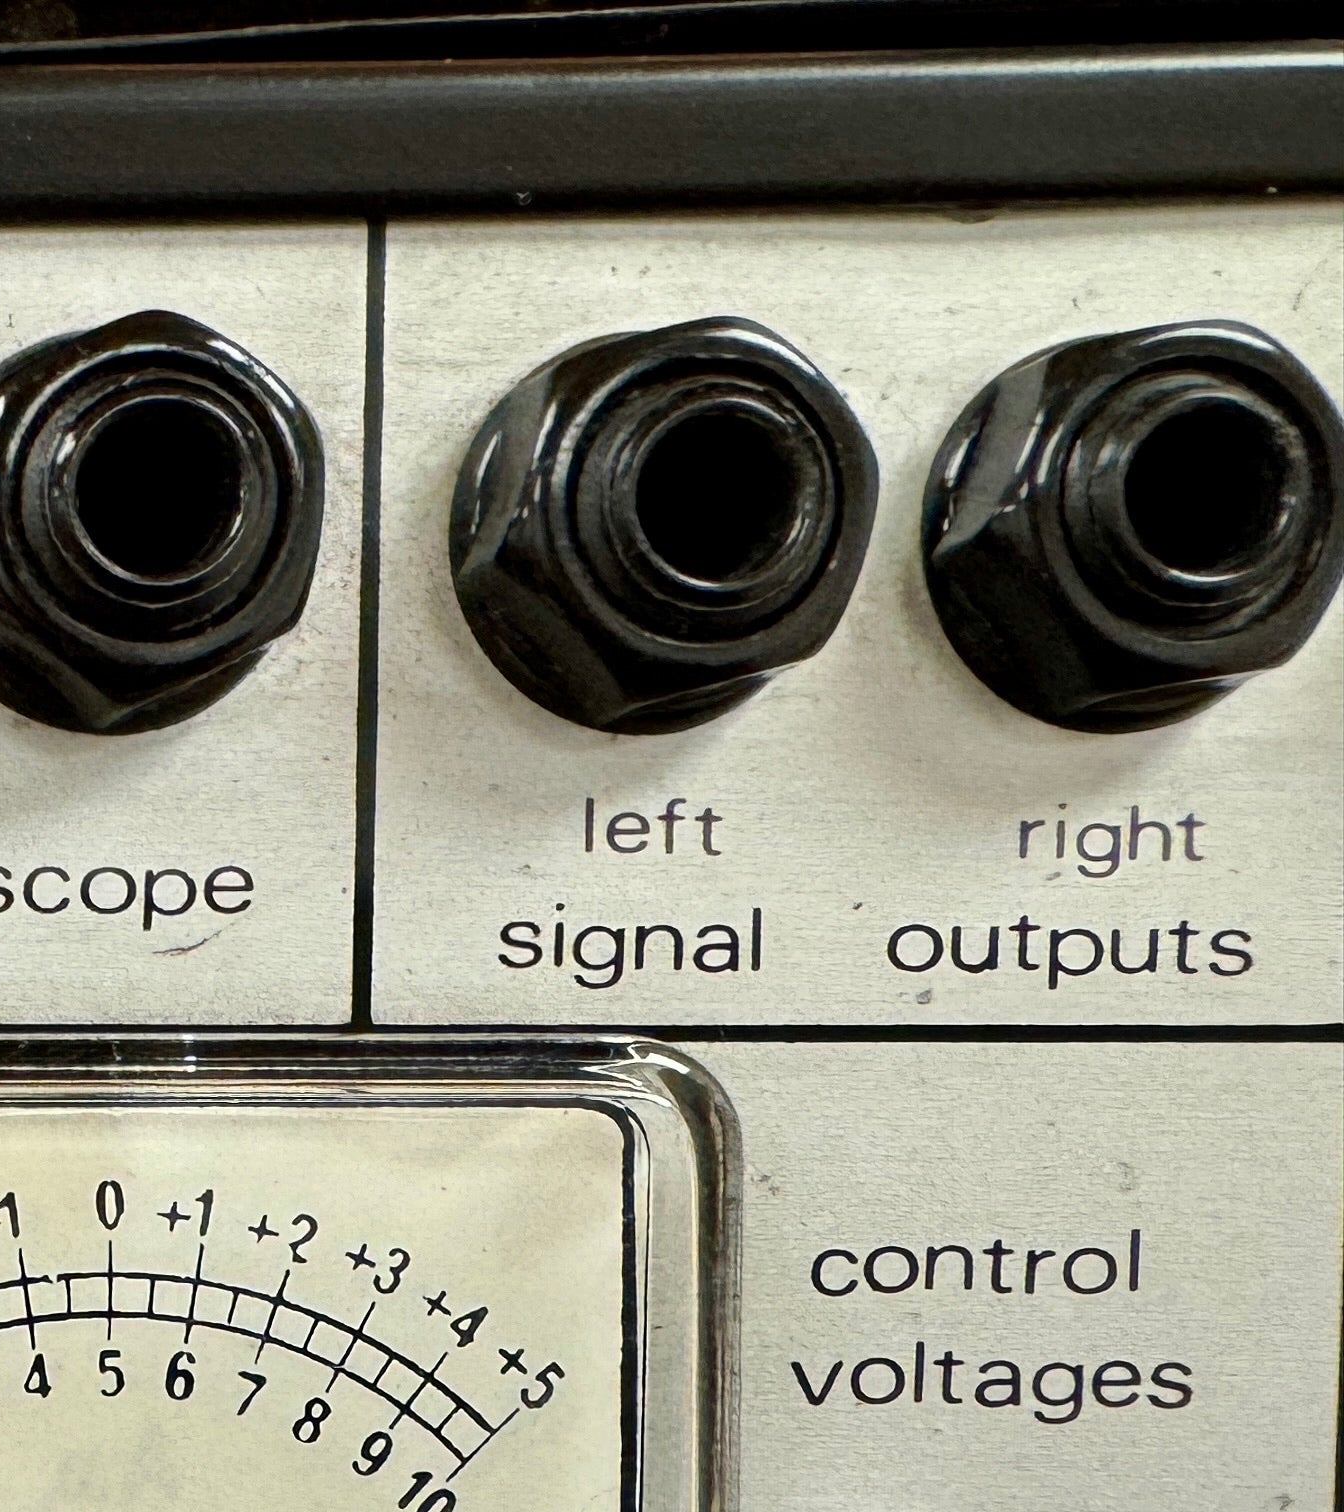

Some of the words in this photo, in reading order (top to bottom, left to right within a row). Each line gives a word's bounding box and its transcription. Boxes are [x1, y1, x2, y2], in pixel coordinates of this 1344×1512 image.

[584, 796, 724, 857] left
[1018, 802, 1206, 879] right
[497, 902, 762, 990] signal
[886, 914, 1254, 991] outputs
[95, 1179, 125, 1231] 0
[156, 1189, 214, 1237] +1
[247, 1213, 319, 1264] +2
[344, 1243, 411, 1295] +3
[422, 1290, 489, 1348] +4
[498, 1348, 566, 1410] +5
[810, 1228, 1141, 1297] control
[23, 1353, 52, 1399] 4
[98, 1349, 125, 1397] 5
[165, 1350, 196, 1401] 6
[236, 1370, 267, 1416] 7
[291, 1398, 329, 1444] 8
[351, 1430, 394, 1477] 9
[790, 1340, 1194, 1425] voltages
